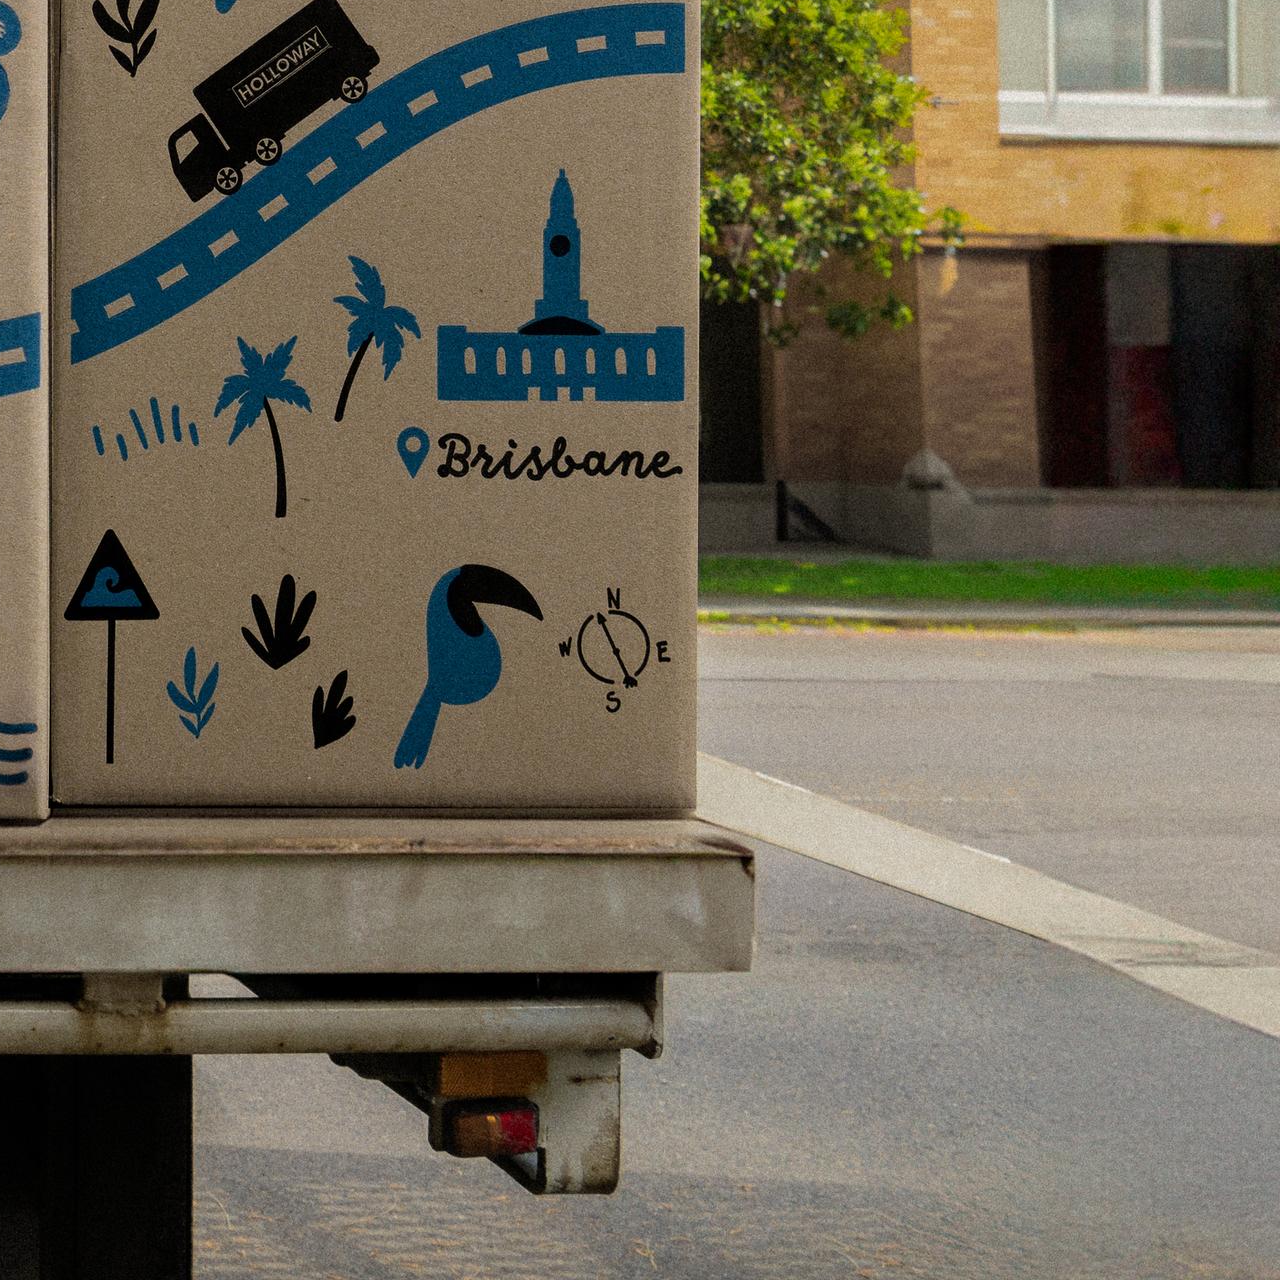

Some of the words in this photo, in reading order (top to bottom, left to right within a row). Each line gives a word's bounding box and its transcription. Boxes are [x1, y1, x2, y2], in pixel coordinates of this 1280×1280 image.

[238, 32, 320, 101] HOLLOWAY
[437, 432, 683, 482] Brisbane
[606, 587, 621, 609] N
[558, 636, 572, 657] W
[656, 641, 671, 663] E
[605, 691, 622, 713] S
